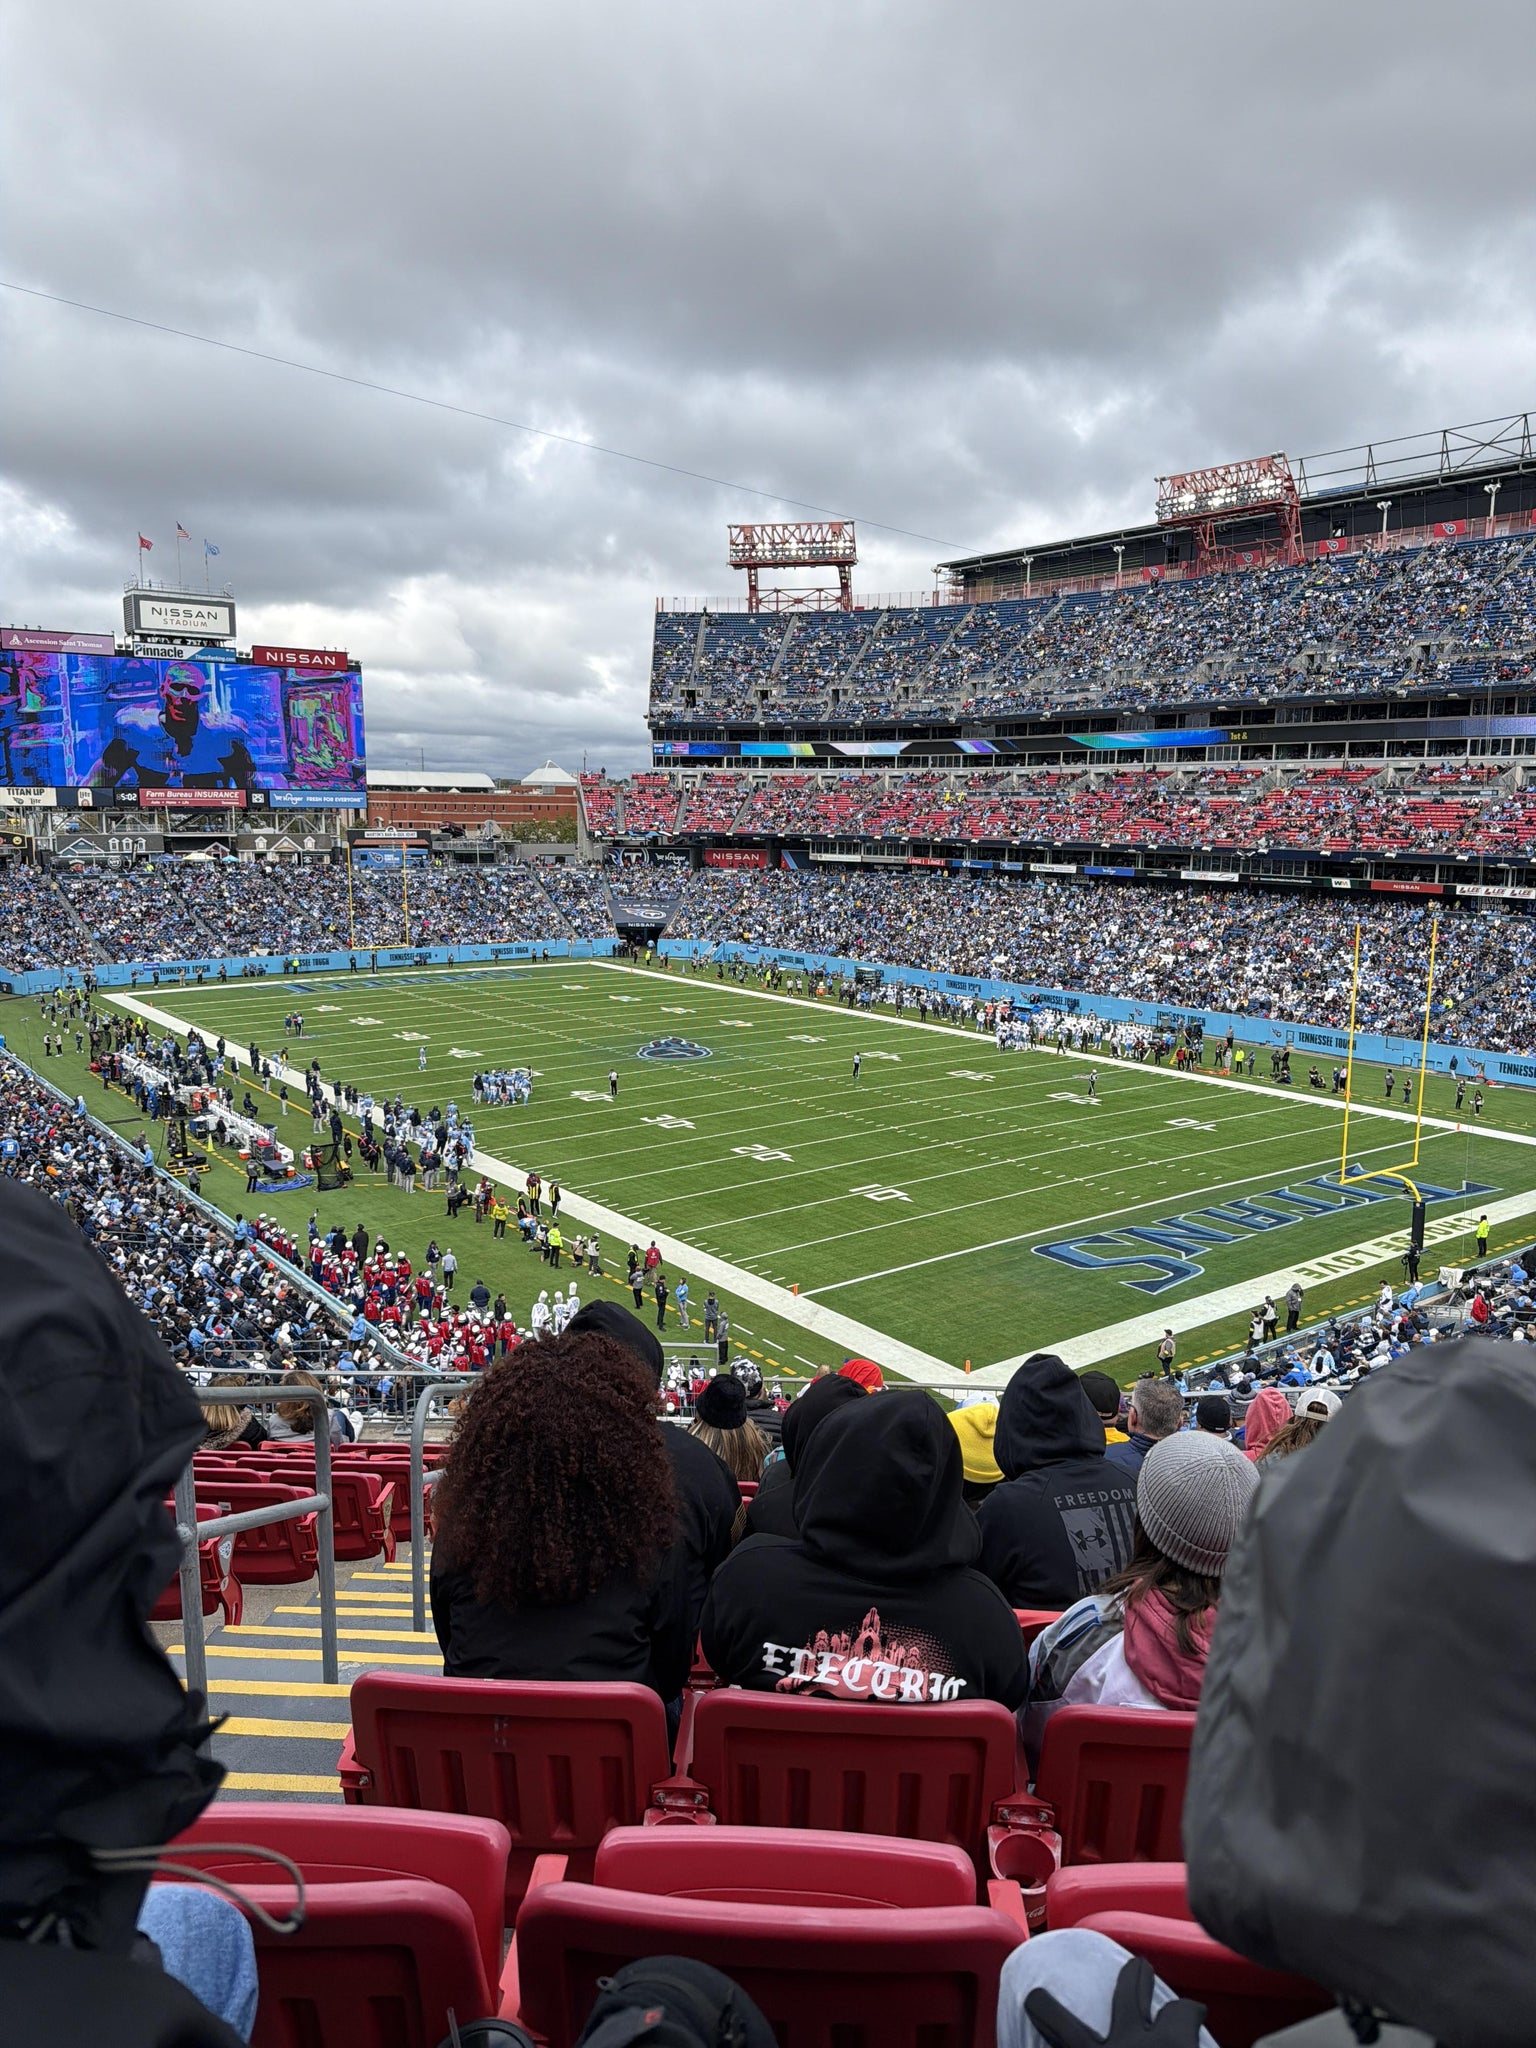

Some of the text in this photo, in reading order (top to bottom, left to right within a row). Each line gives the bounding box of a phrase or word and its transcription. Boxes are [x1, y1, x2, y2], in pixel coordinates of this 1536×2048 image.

[151, 607, 218, 620] NISSAN
[163, 618, 208, 627] STADIUM
[24, 637, 58, 645] Ascension
[77, 640, 103, 648] Thomas
[135, 643, 184, 658] Pinnacle
[266, 651, 336, 666] NISSAN
[1230, 732, 1240, 740] 1st
[7, 788, 45, 796] TITAN UP
[664, 852, 686, 865] Kroger
[712, 852, 760, 861] NISSAN
[1299, 1031, 1333, 1047] TENNESSEE
[730, 1143, 793, 1162] 20
[850, 1184, 910, 1201] 10
[1293, 1249, 1384, 1280] LOVE
[1053, 1488, 1135, 1508] FREEDOM
[762, 1642, 967, 1702] ELECTRIC
